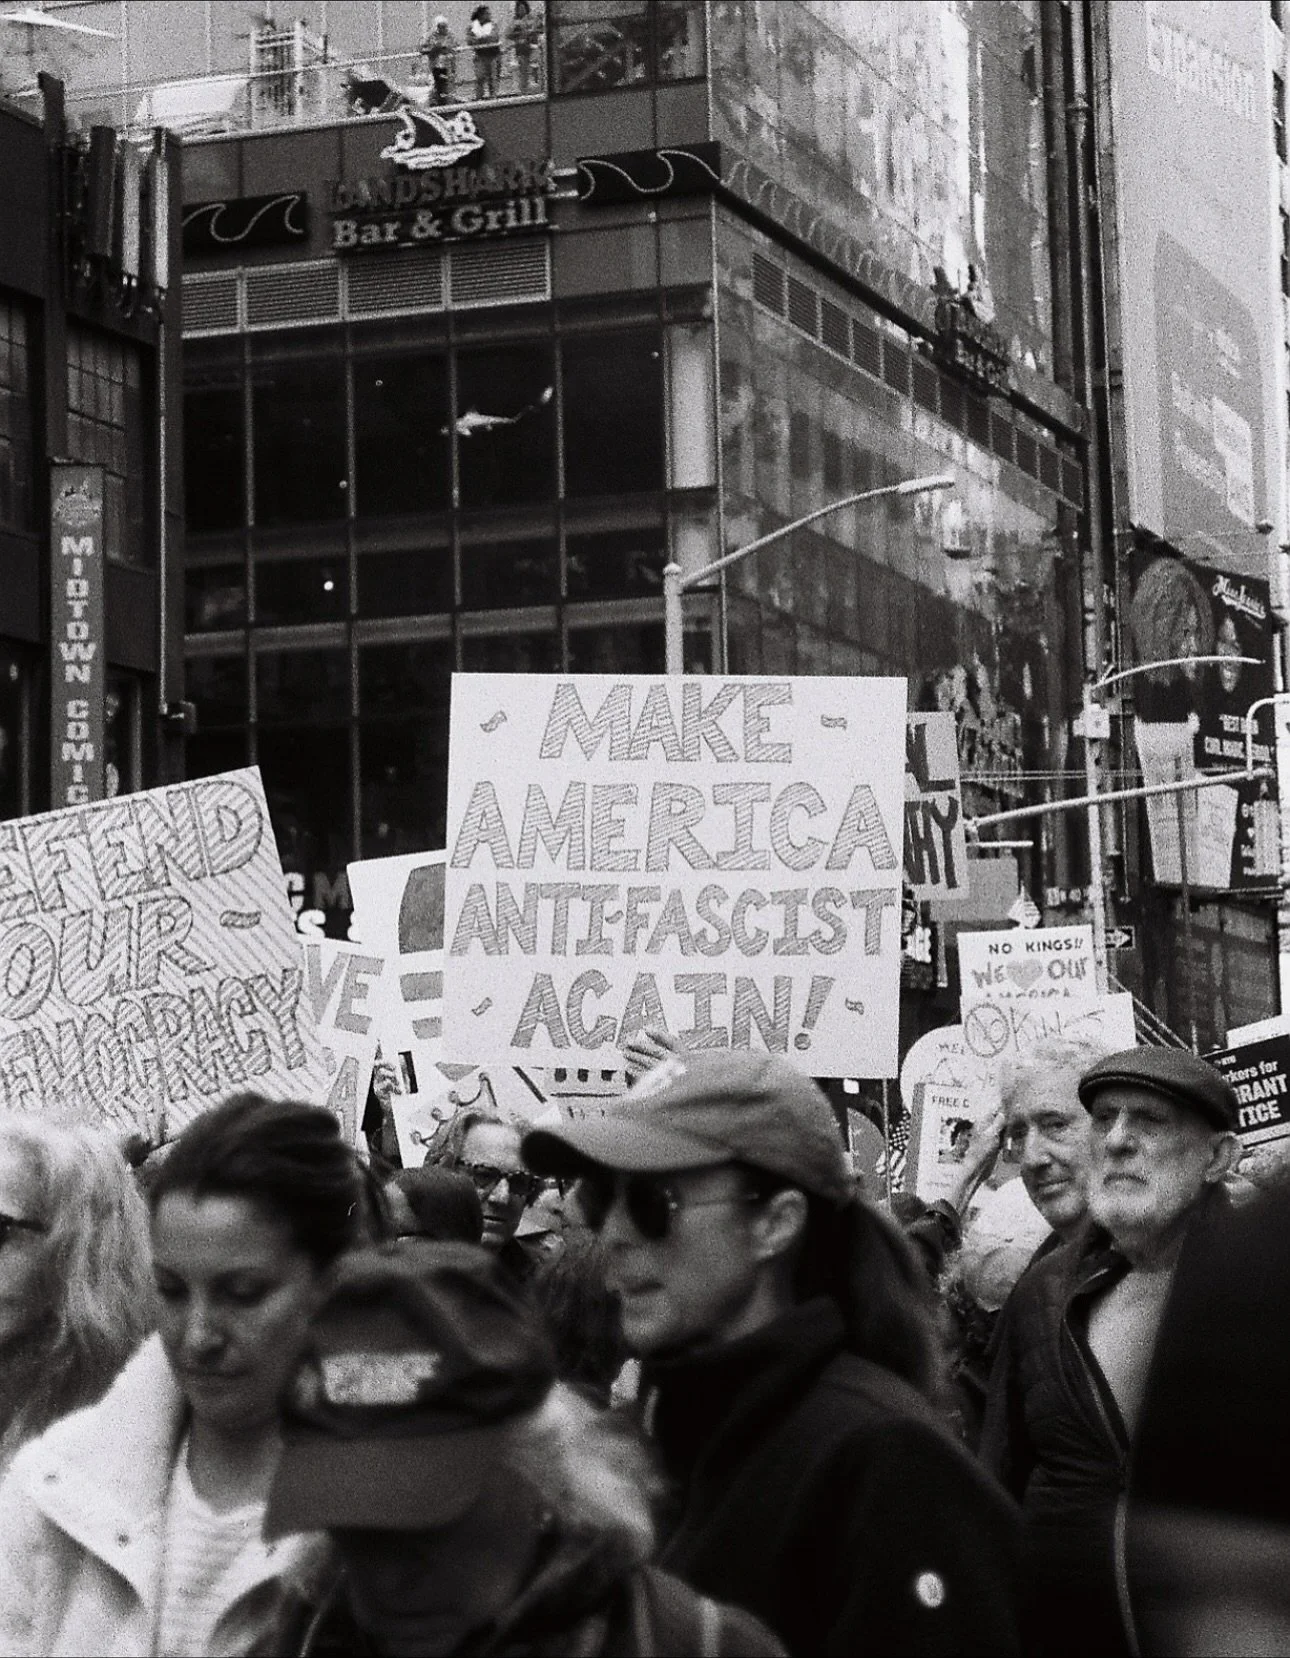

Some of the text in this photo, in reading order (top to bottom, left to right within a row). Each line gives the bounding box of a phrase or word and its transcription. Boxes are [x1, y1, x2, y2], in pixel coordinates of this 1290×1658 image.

[332, 197, 549, 248] Bar & Grill
[59, 536, 97, 683] MIDTOWN
[539, 682, 794, 764] MAKE
[449, 780, 898, 873] AMERICA
[0, 894, 217, 1021] OUR
[449, 881, 898, 958] ANTI-FASCIST
[988, 937, 1084, 955] NO KINGS!!
[510, 968, 836, 1054] AGAIN!
[1222, 1061, 1279, 1083] rkers for
[1233, 1073, 1288, 1104] RANT
